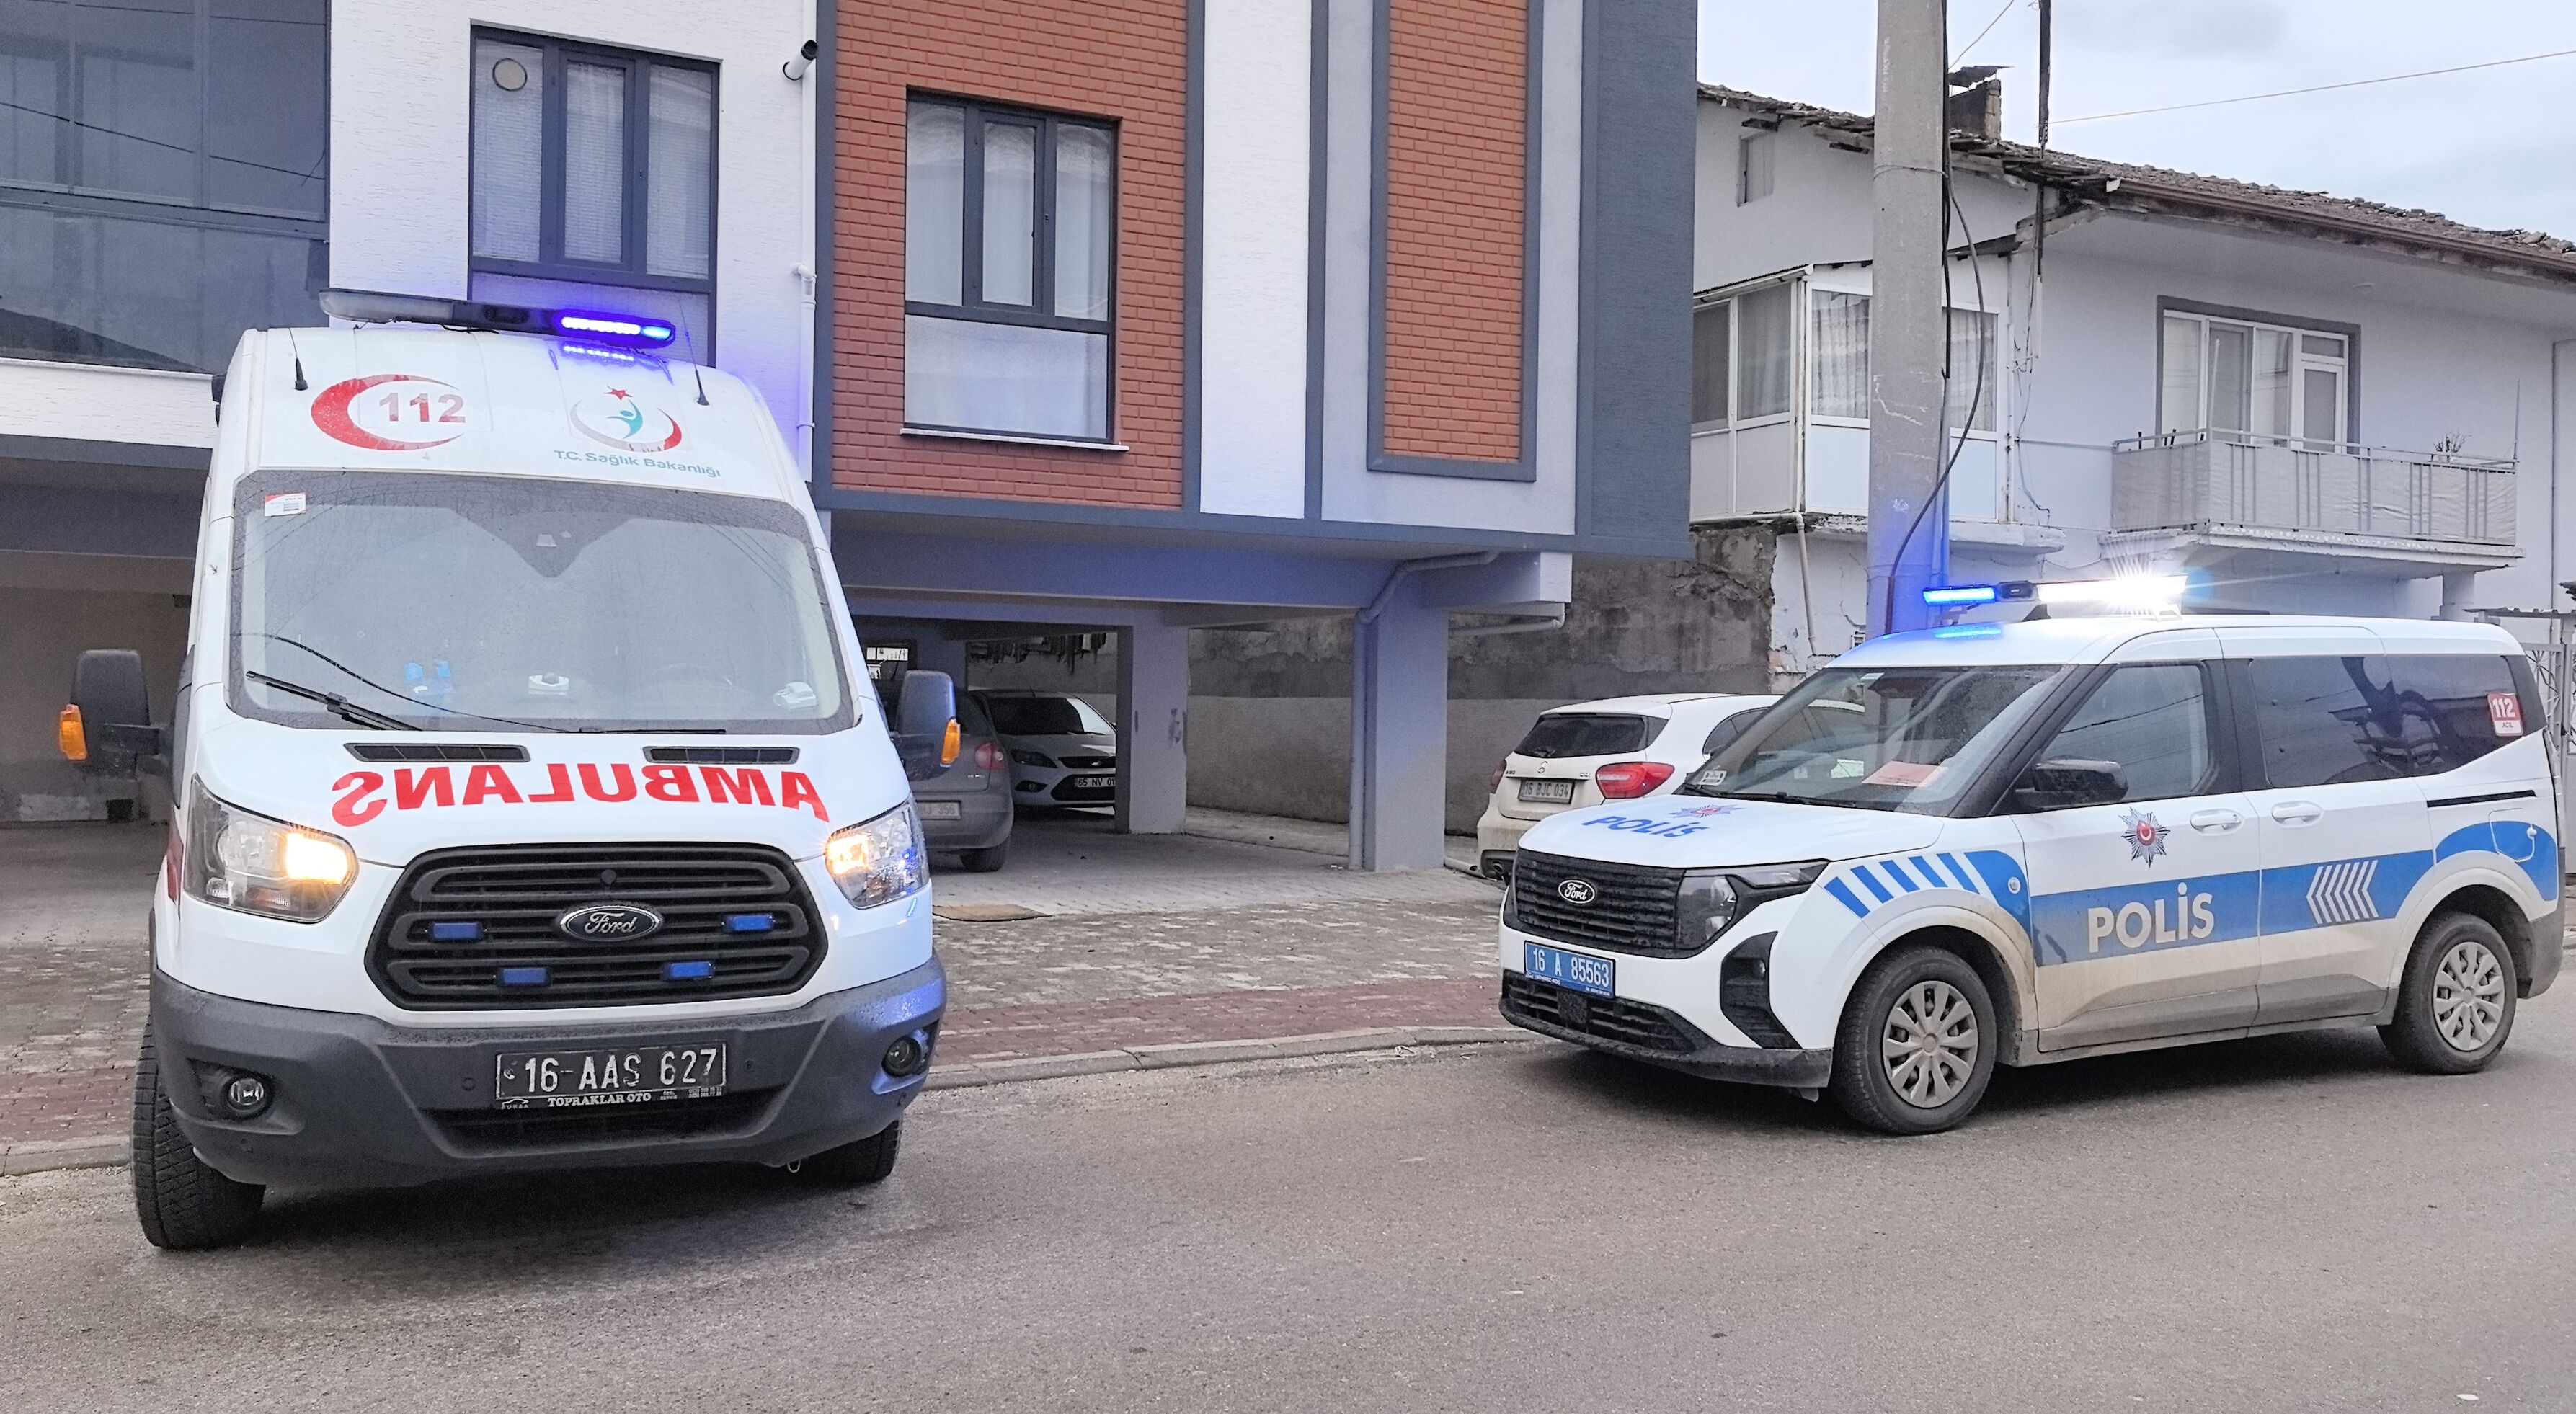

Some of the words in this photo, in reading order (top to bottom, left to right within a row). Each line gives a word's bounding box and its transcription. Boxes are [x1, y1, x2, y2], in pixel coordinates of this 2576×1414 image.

[379, 392, 466, 423] 112
[554, 450, 582, 461] T.C.
[585, 452, 639, 466] Sağlık
[644, 458, 721, 478] Bakanlığı
[2492, 698, 2515, 718] 112
[1092, 778, 1103, 786] NV
[1581, 816, 1710, 837] POLİS
[1565, 883, 1588, 900] Ford
[585, 912, 637, 934] Ford
[2087, 881, 2214, 953] POLİS
[1533, 948, 1545, 971] 16
[1555, 953, 1563, 977] A
[1571, 956, 1609, 987] 85563
[660, 1048, 716, 1085] 627
[548, 1093, 625, 1107] TOPRAKLAR
[626, 1093, 652, 1103] OTO
